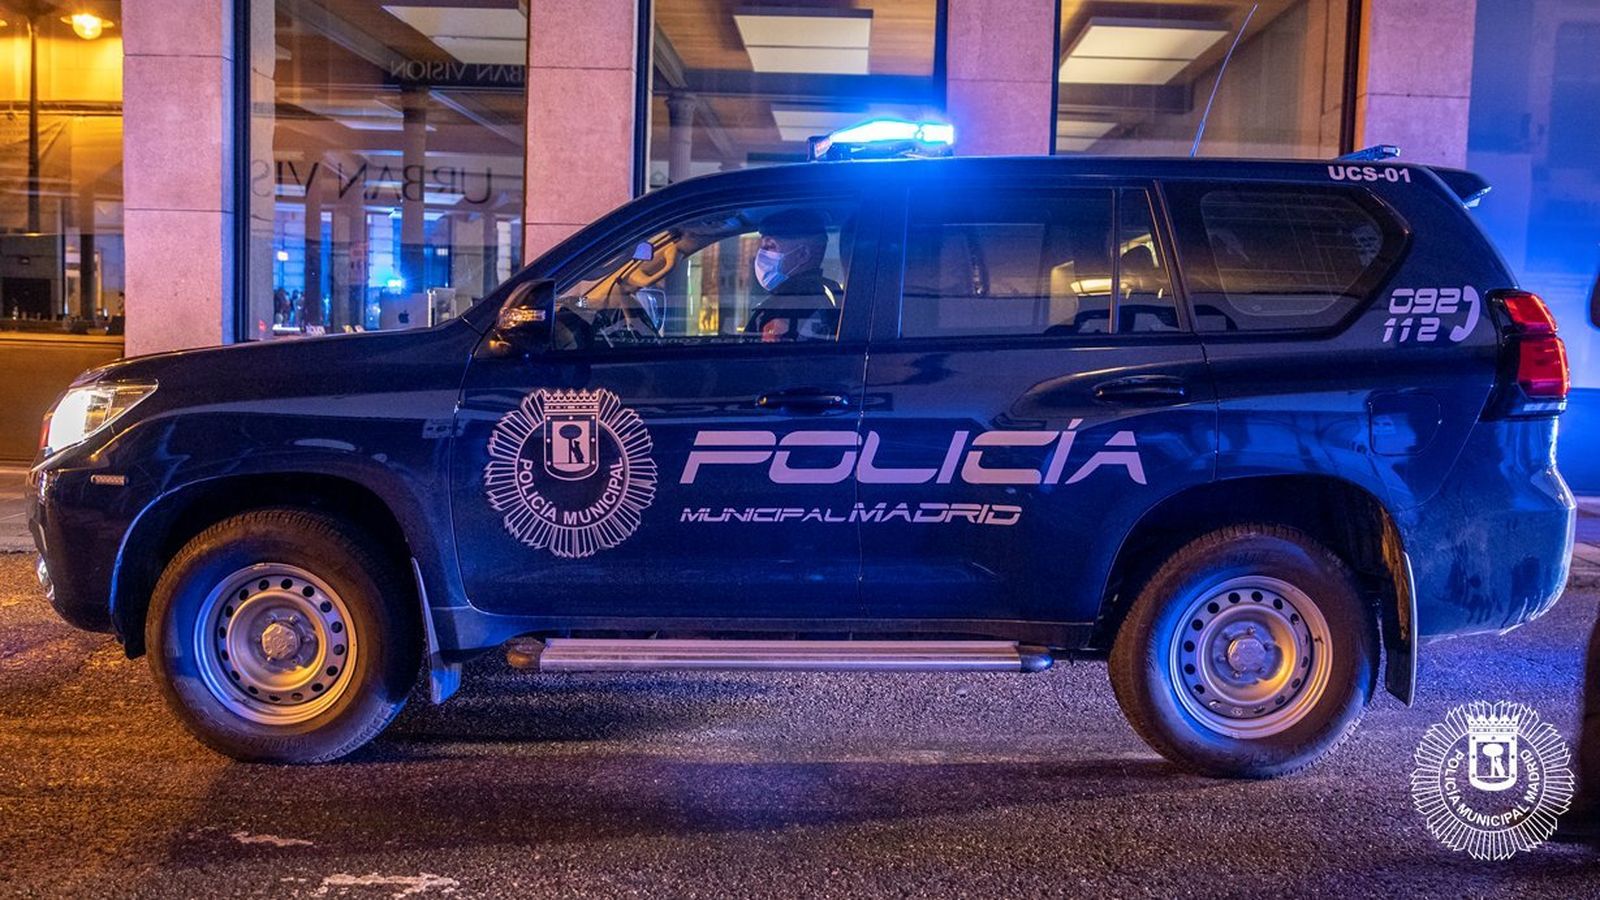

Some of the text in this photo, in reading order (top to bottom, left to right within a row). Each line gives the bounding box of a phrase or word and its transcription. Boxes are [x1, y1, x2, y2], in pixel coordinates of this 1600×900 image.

[1327, 165, 1412, 183] UCS-01
[1389, 288, 1462, 314] 092
[1383, 317, 1441, 343] 112
[679, 418, 1148, 485] POLICÍA
[519, 457, 625, 526] POLICÍA MUNICIPAL
[680, 503, 1022, 526] MUNICIPAL MADRID
